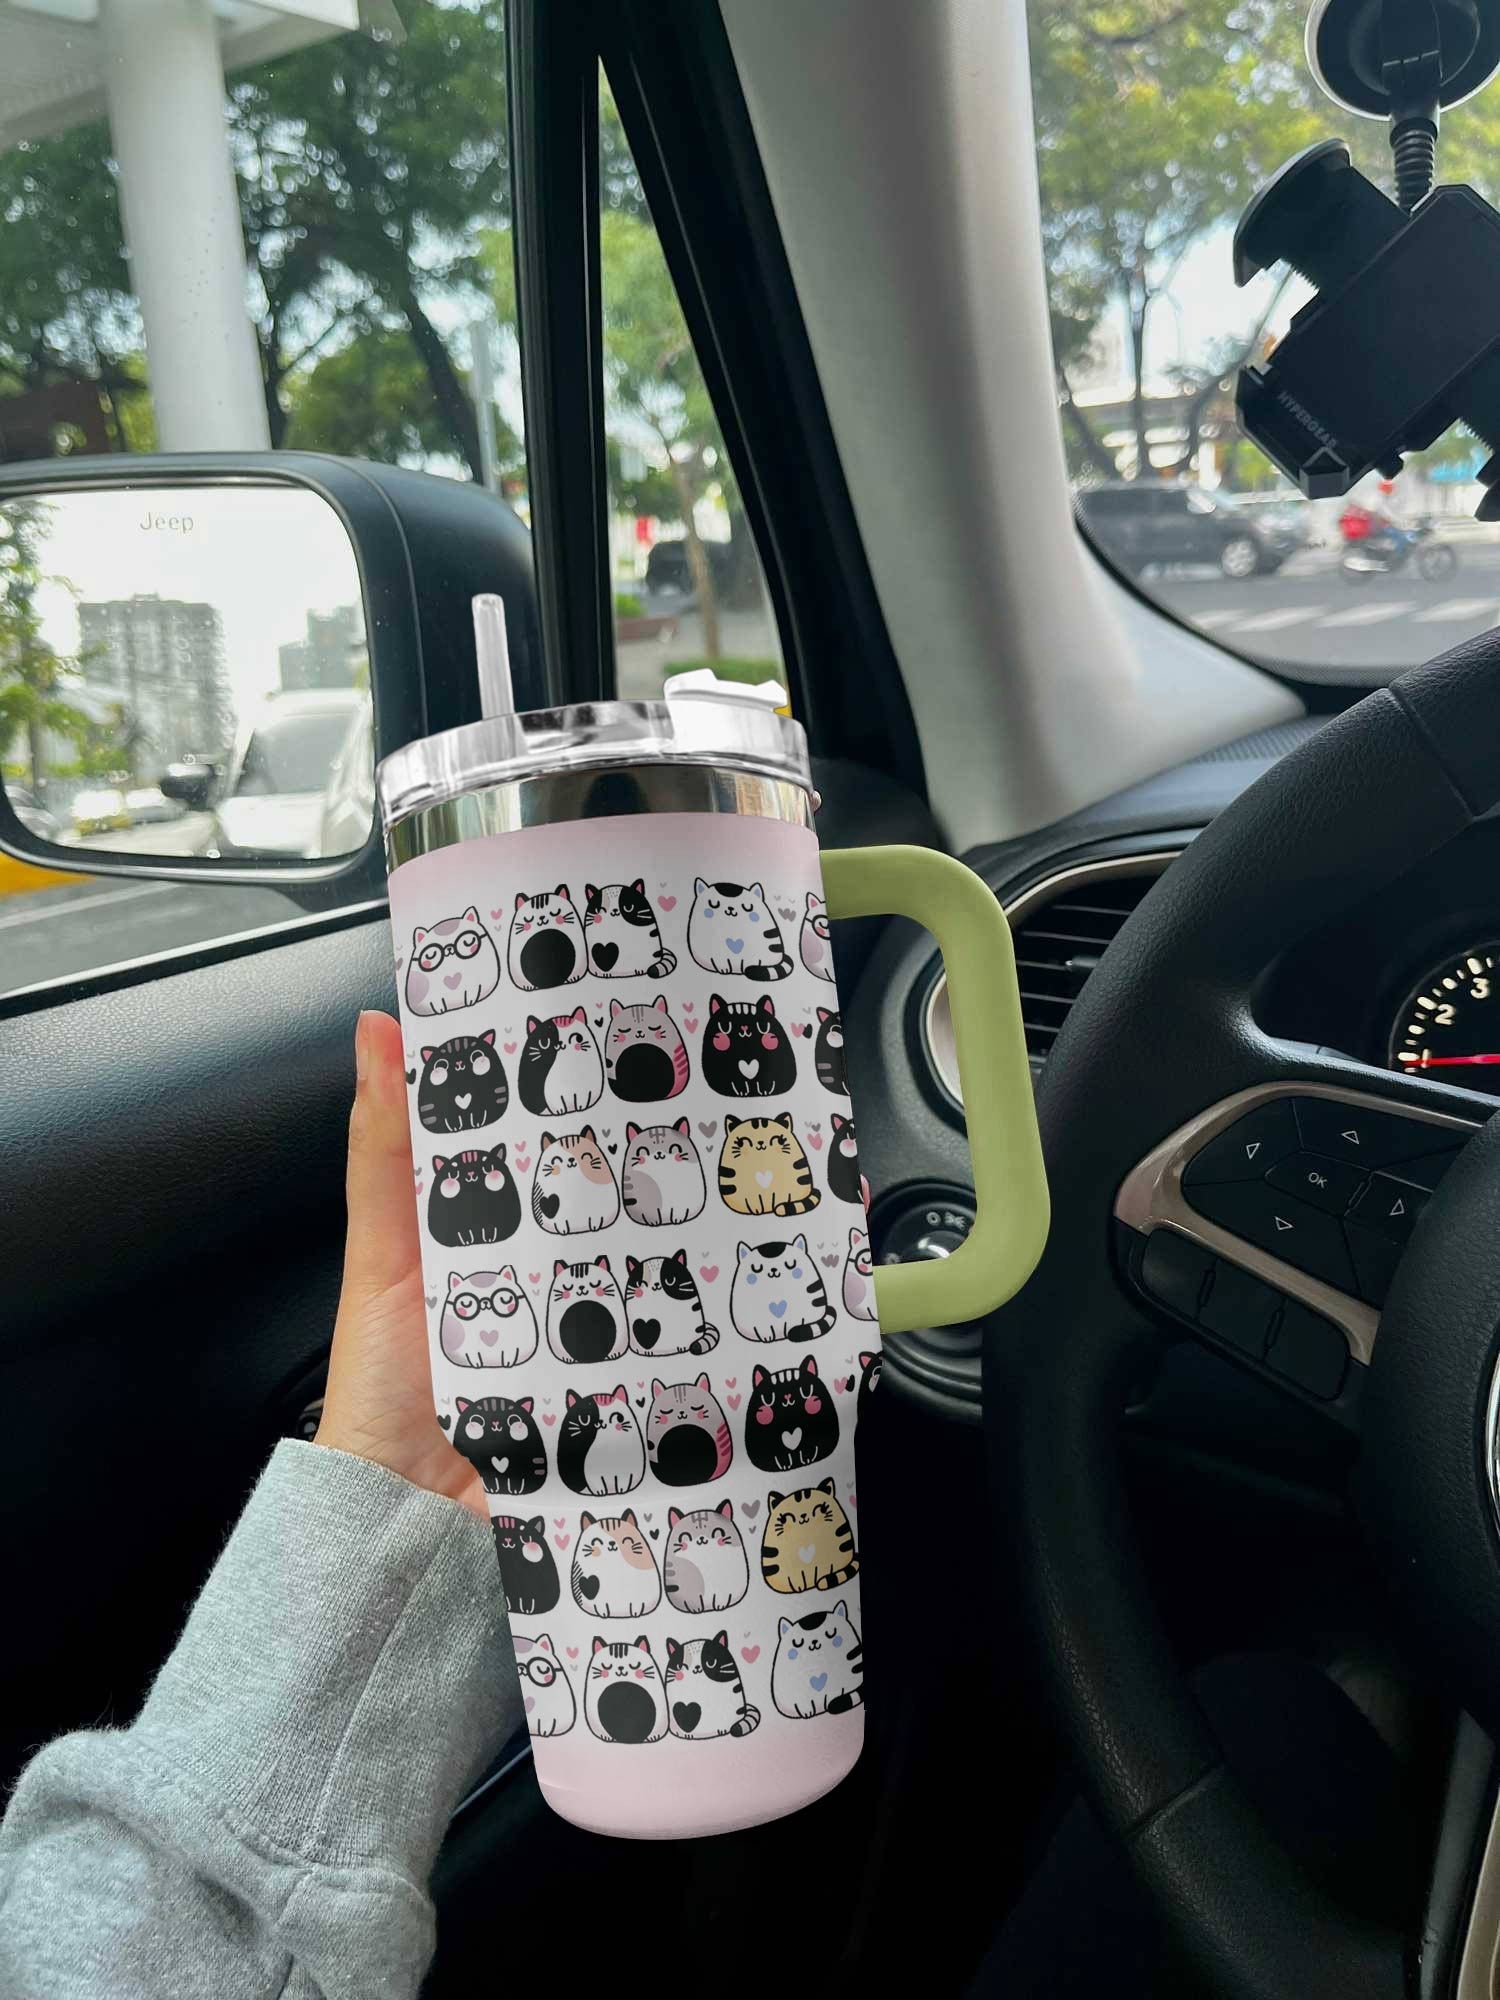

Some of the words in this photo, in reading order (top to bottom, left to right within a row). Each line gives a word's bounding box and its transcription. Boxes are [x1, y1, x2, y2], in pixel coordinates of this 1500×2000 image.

[1277, 391, 1337, 449] HYPERGEAR
[139, 511, 194, 534] Jeep
[1470, 977, 1489, 999] 3
[1435, 1003, 1456, 1025] 2
[1308, 1172, 1328, 1189] OK
